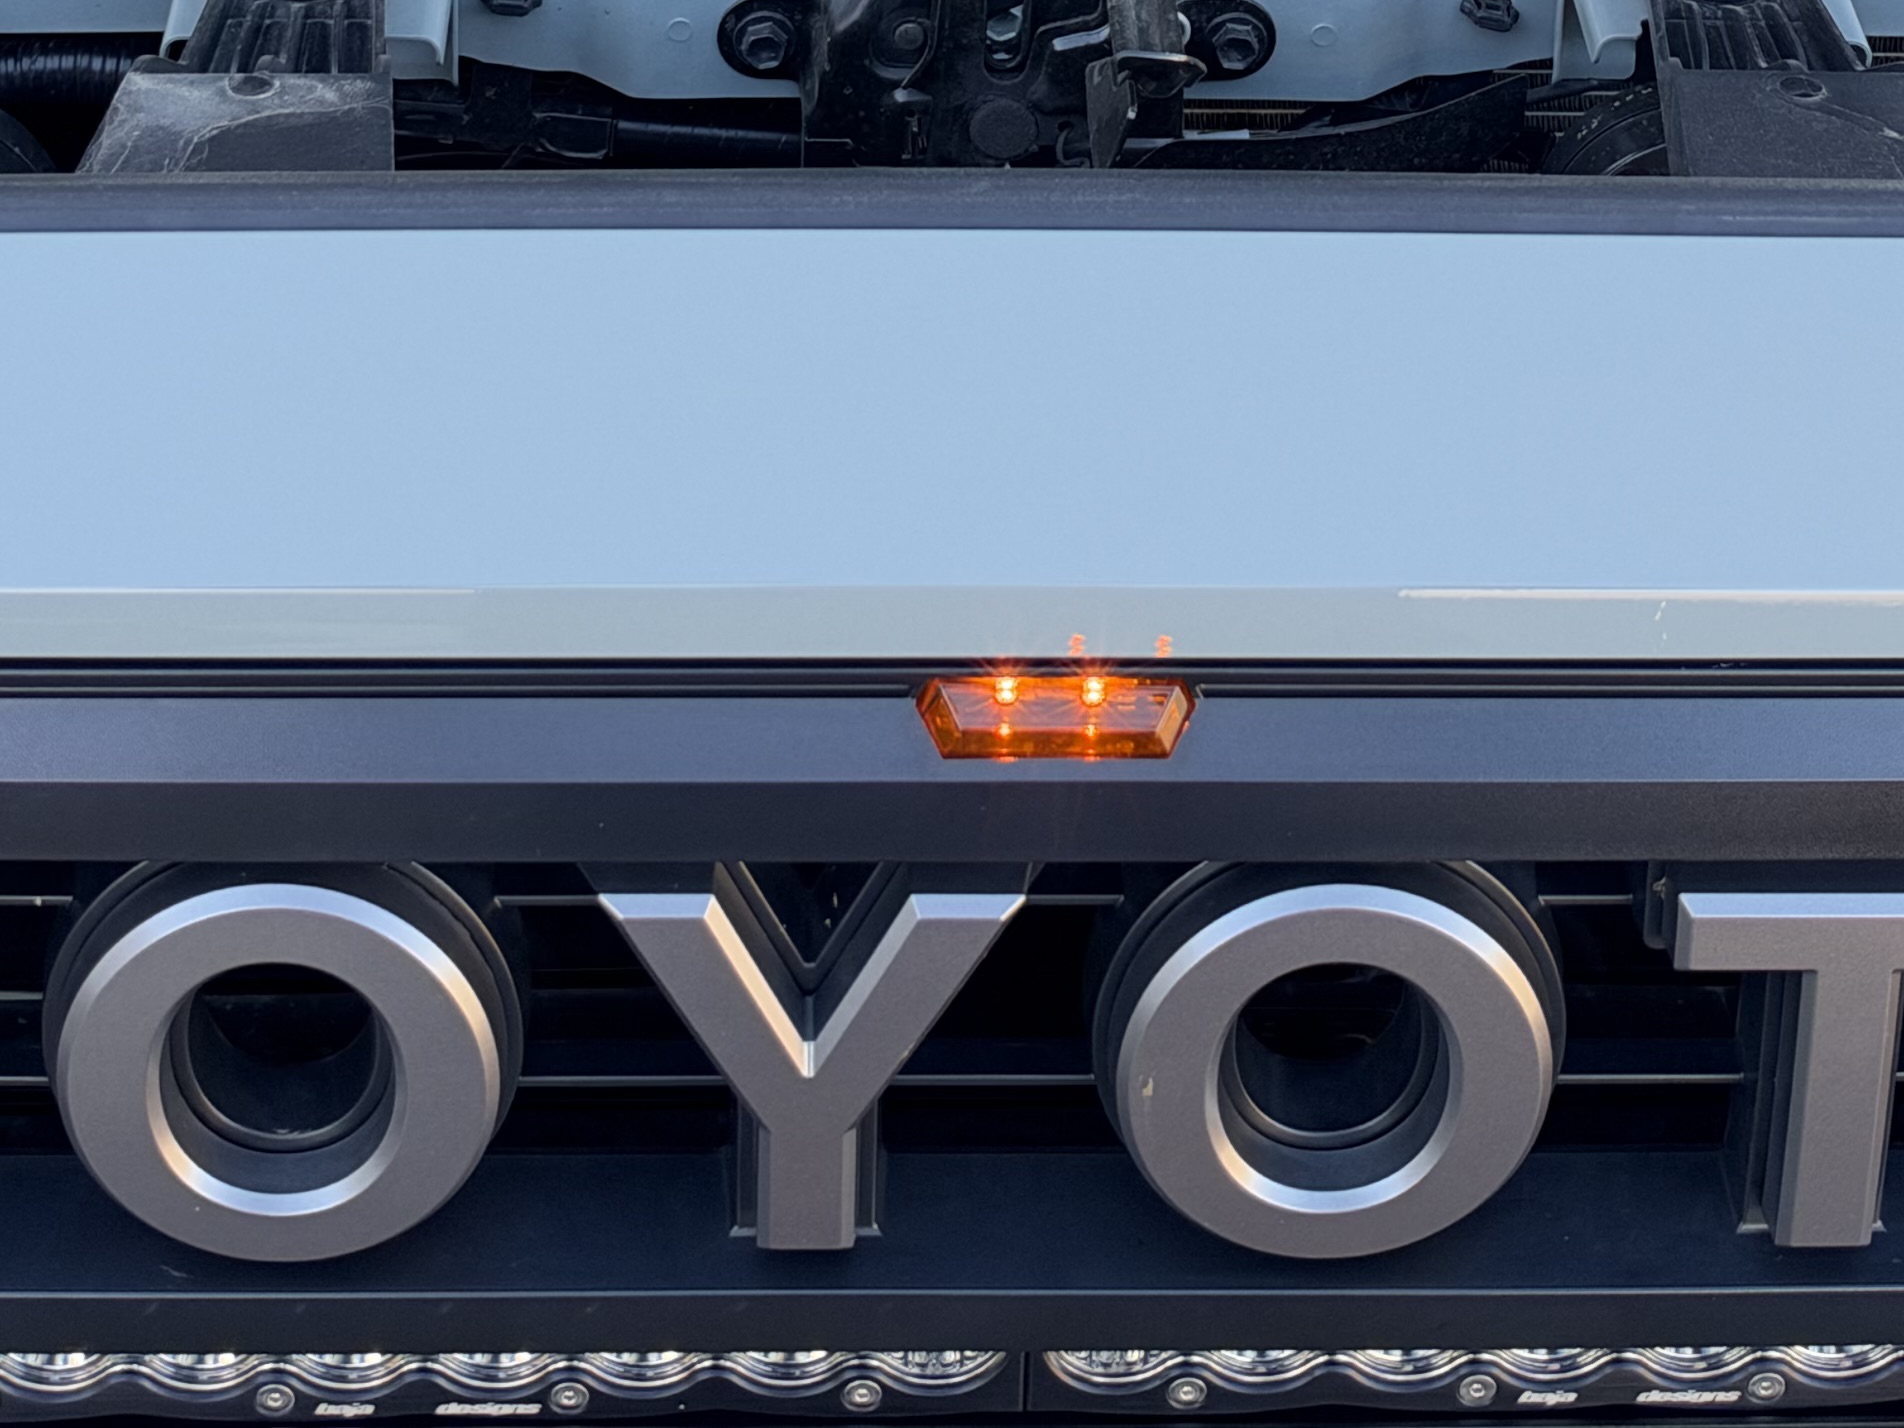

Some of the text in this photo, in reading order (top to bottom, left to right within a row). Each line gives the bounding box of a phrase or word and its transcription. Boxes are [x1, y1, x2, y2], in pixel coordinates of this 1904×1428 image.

[1516, 1390, 1742, 1406] baja designs
[434, 1402, 543, 1416] designs
